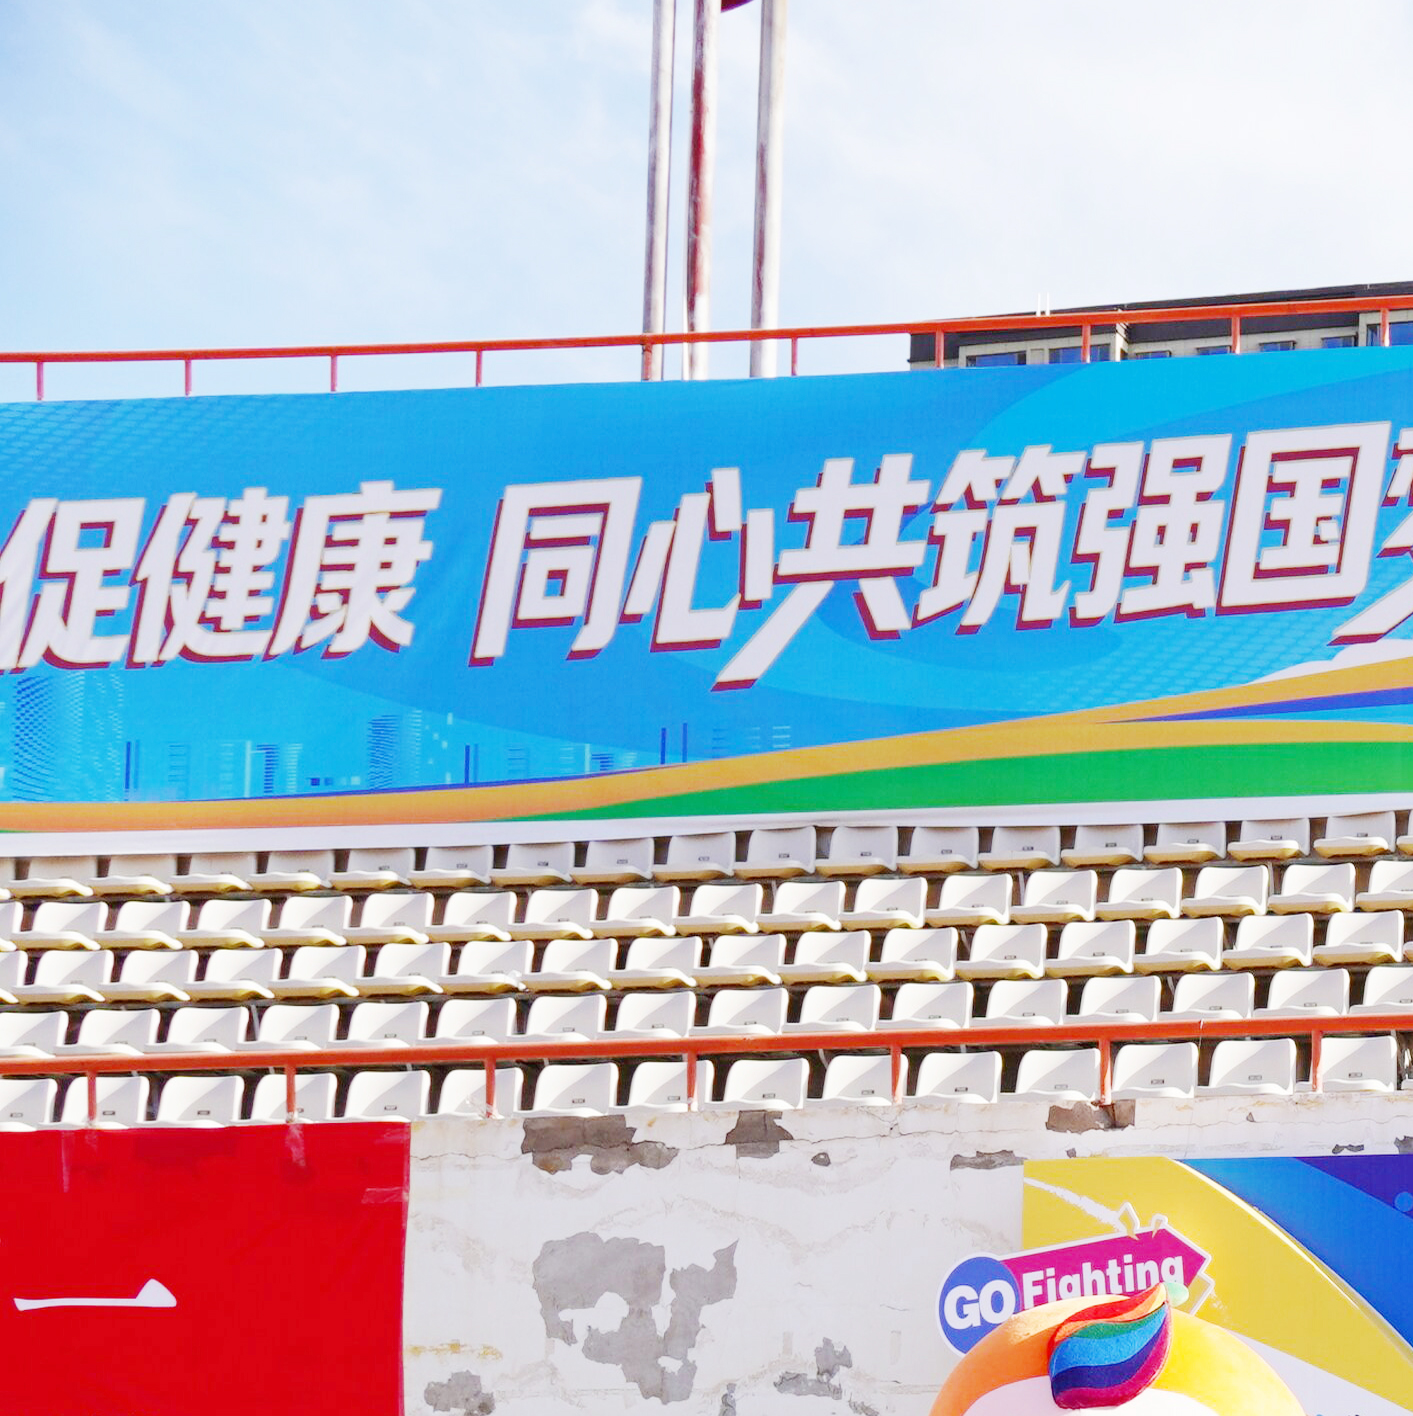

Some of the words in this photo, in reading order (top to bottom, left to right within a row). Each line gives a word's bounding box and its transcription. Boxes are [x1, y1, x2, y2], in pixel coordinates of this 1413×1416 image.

[0, 481, 443, 672] 促健康
[943, 1279, 1017, 1331] GO
